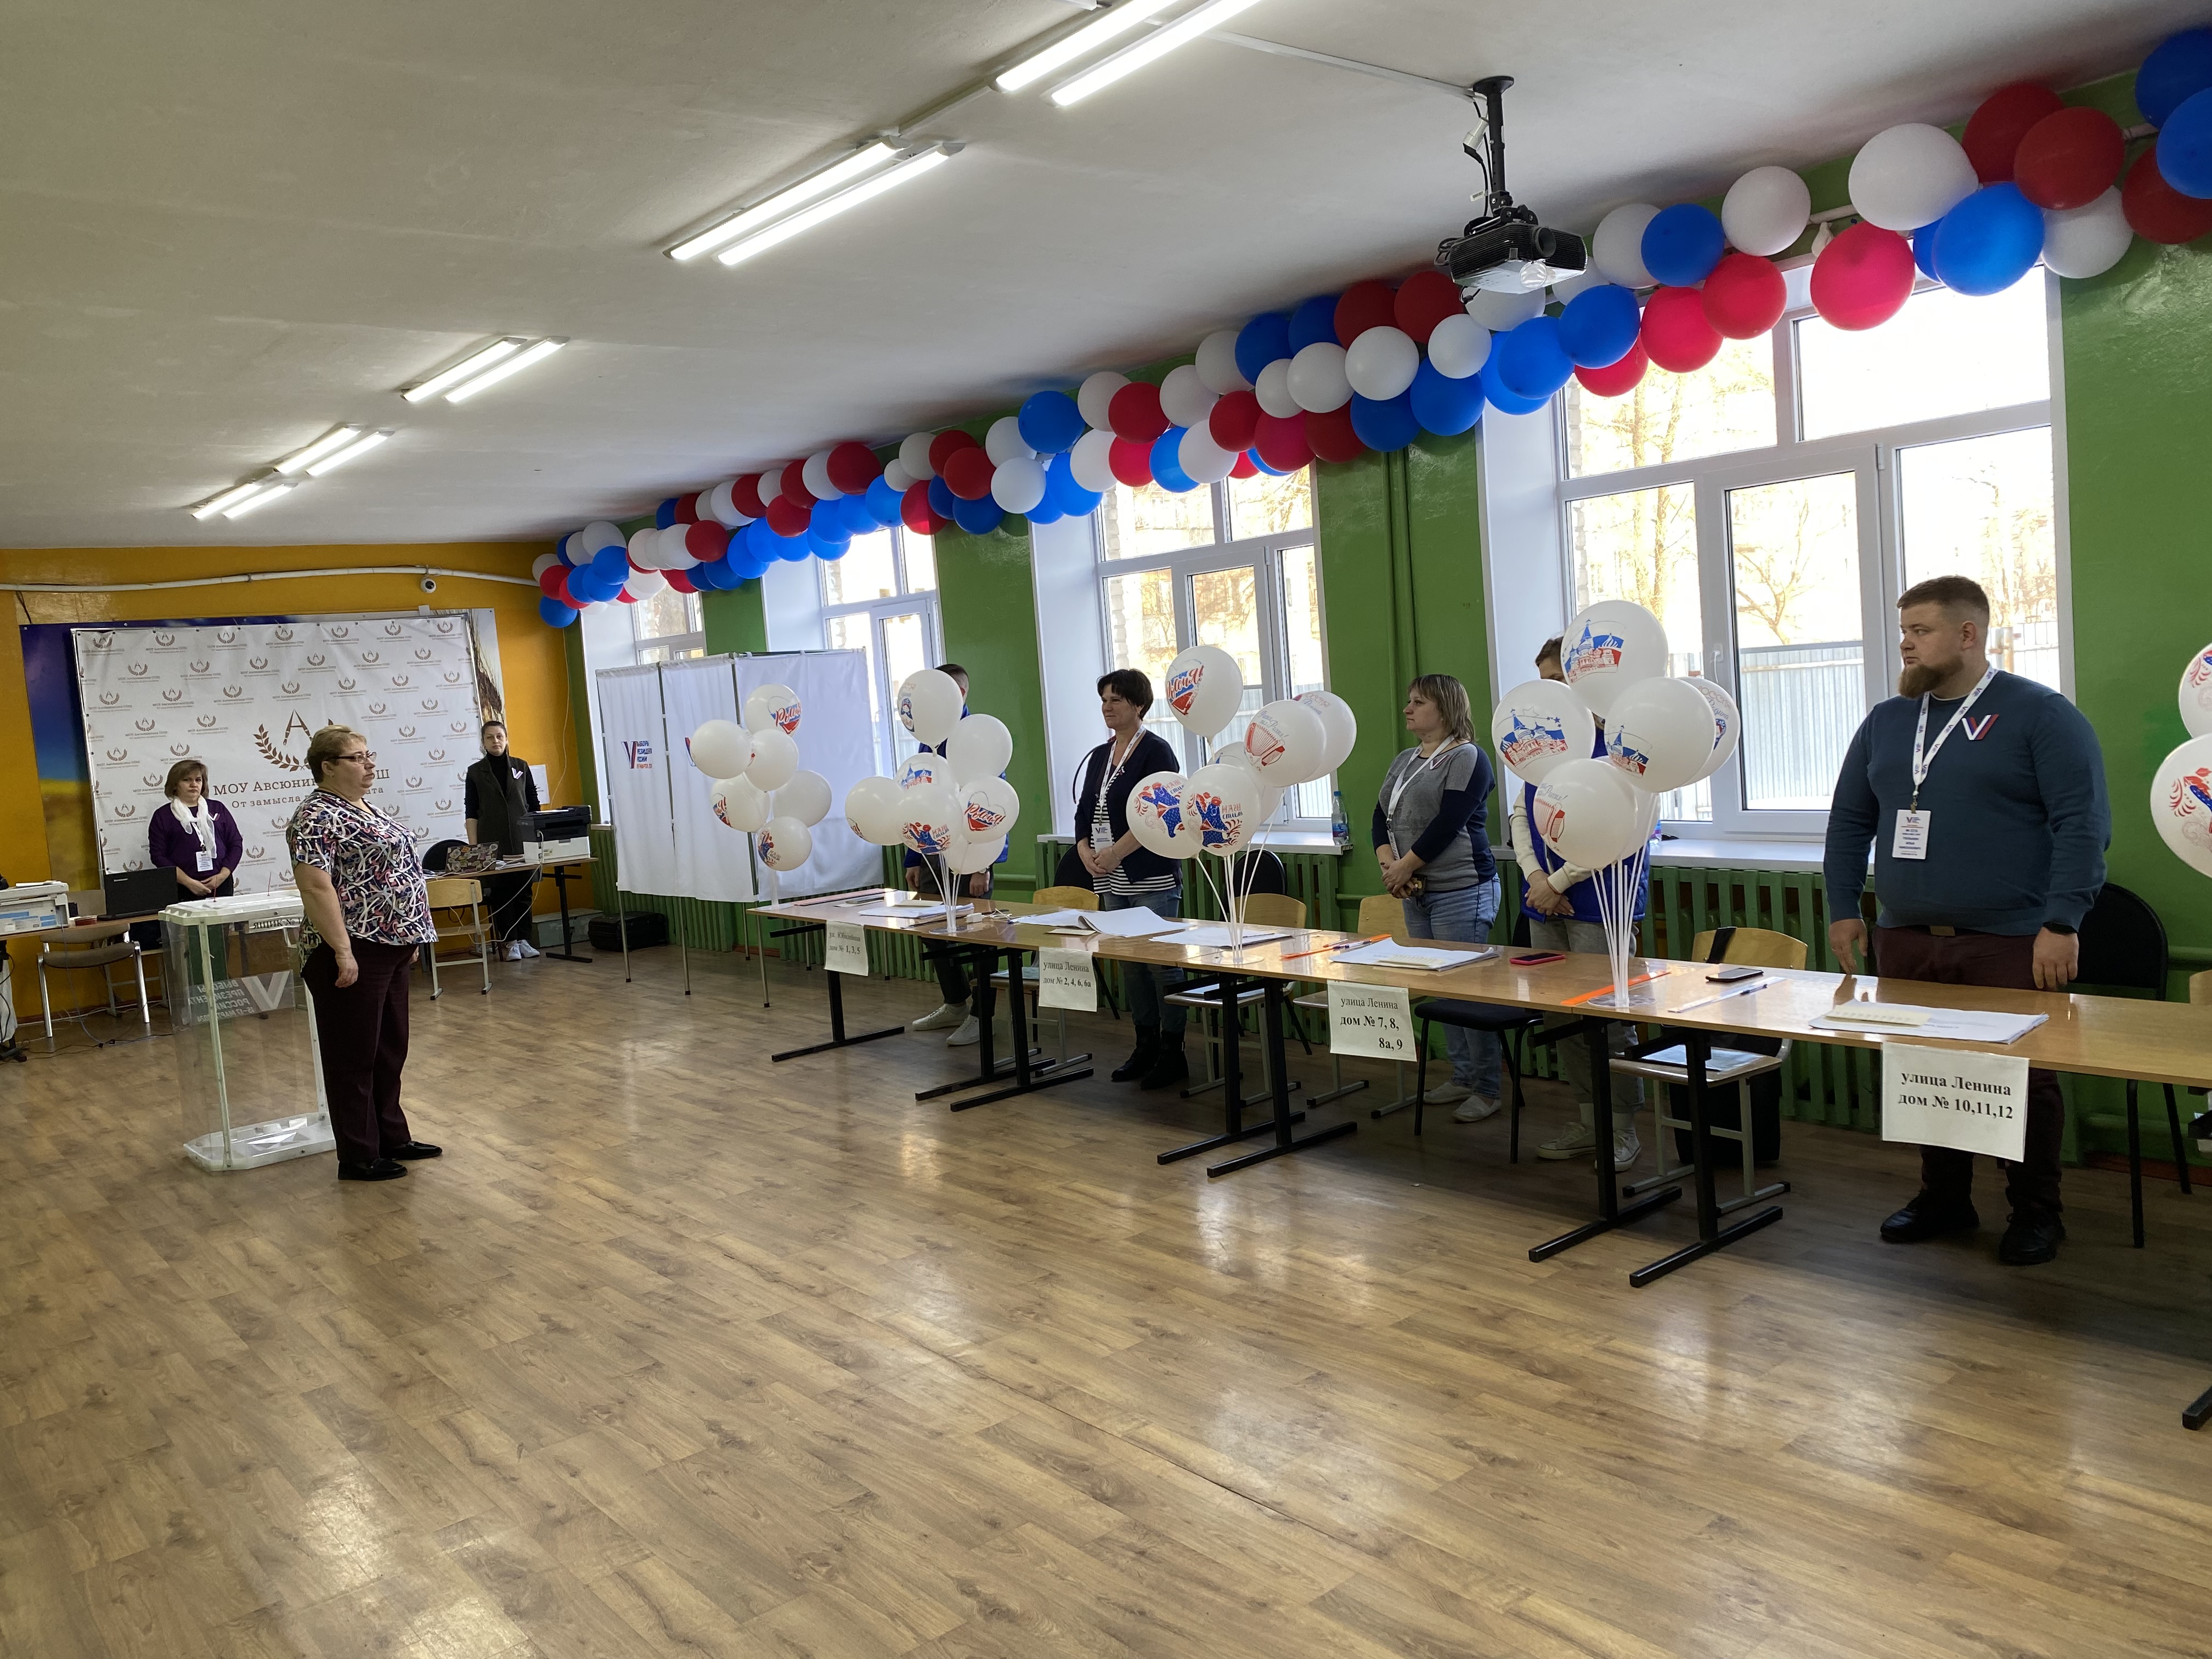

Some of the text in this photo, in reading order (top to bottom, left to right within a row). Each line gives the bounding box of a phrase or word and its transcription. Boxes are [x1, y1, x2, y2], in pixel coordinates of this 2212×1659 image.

[213, 778, 317, 795] МОУ Авсюни
[250, 795, 301, 806] замысла
[1221, 803, 1242, 814] НАШ
[253, 919, 283, 929] ЯЩИК
[1043, 962, 1090, 972] улица Ленина
[1084, 979, 1091, 988] 6а
[1340, 998, 1398, 1009] улица Ленина
[1340, 1015, 1399, 1031] дом № 7, 8,
[1396, 1039, 1403, 1050] 9
[1901, 1073, 2011, 1096] улица Ленина
[1898, 1094, 2013, 1119] дом № 10,11,12
